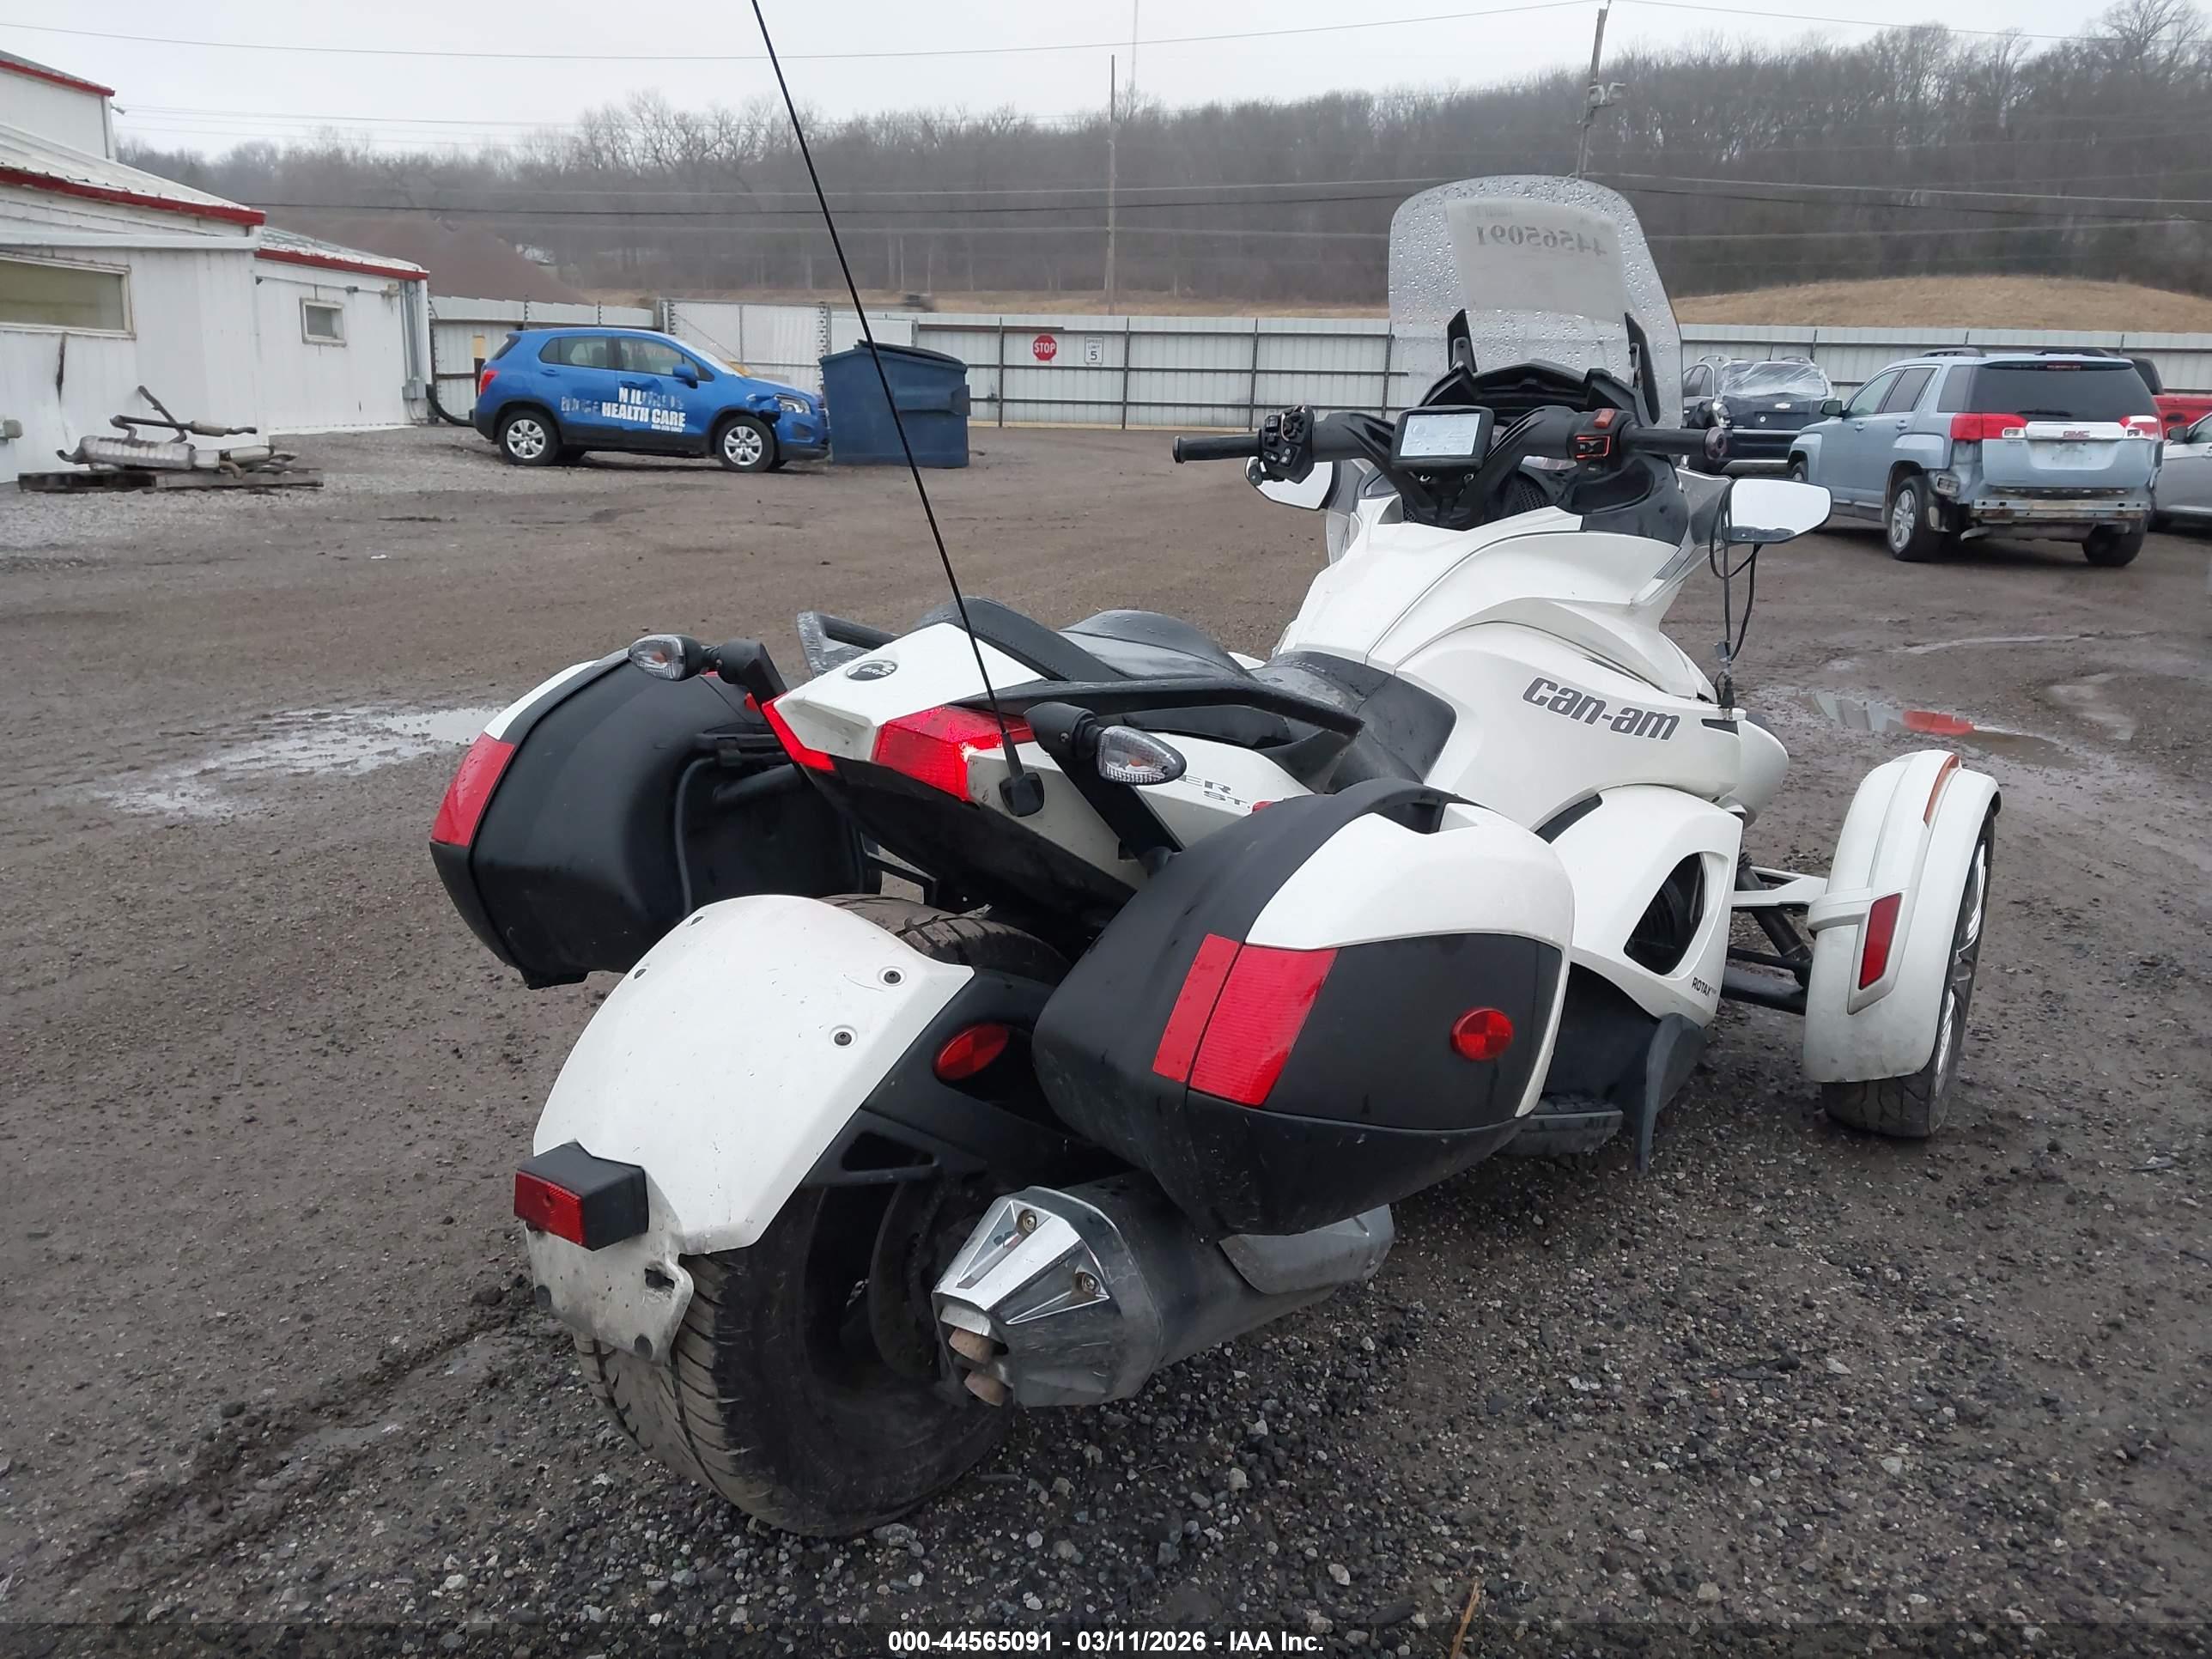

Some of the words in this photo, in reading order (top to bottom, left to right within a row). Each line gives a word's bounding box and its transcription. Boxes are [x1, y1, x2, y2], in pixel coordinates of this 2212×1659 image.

[1034, 342, 1056, 354] STOP
[1090, 350, 1098, 361] 5
[601, 401, 649, 422] HEALTH
[651, 408, 686, 428] CARE
[2062, 429, 2090, 439] GMC
[1522, 677, 1680, 741] can-am
[1692, 976, 1711, 997] ROTAX
